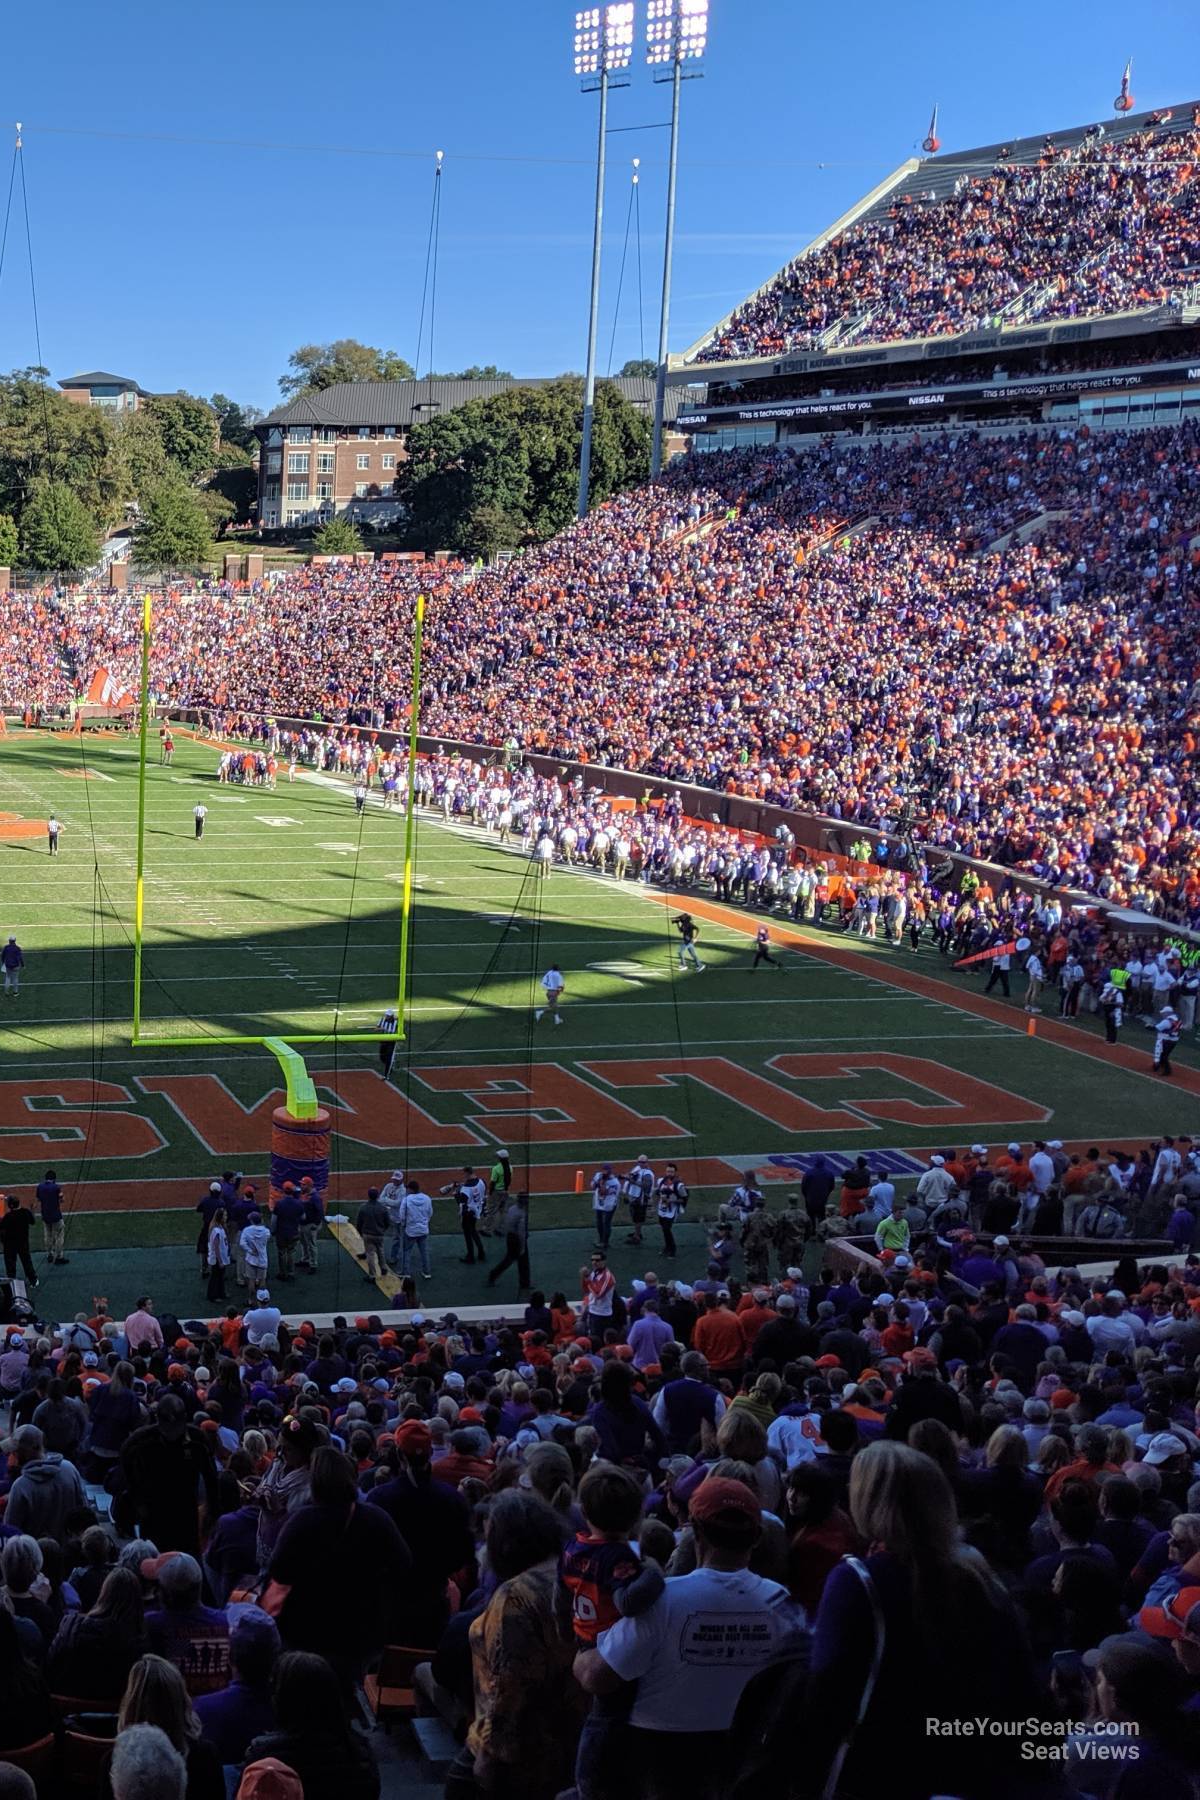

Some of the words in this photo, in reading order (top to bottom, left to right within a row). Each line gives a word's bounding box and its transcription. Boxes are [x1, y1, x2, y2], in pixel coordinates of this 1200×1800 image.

[983, 389, 998, 398] This
[1006, 385, 1048, 397] technology
[1049, 383, 1066, 392] that
[1067, 381, 1088, 392] helps
[1089, 379, 1111, 388] react
[1112, 376, 1124, 385] for
[908, 394, 945, 405] NISSAN
[739, 411, 753, 419] This
[759, 408, 795, 418] technology
[795, 406, 809, 415] that
[810, 404, 828, 414] helps
[829, 403, 847, 411] react
[847, 402, 857, 410] for
[676, 415, 707, 425] NISSAN
